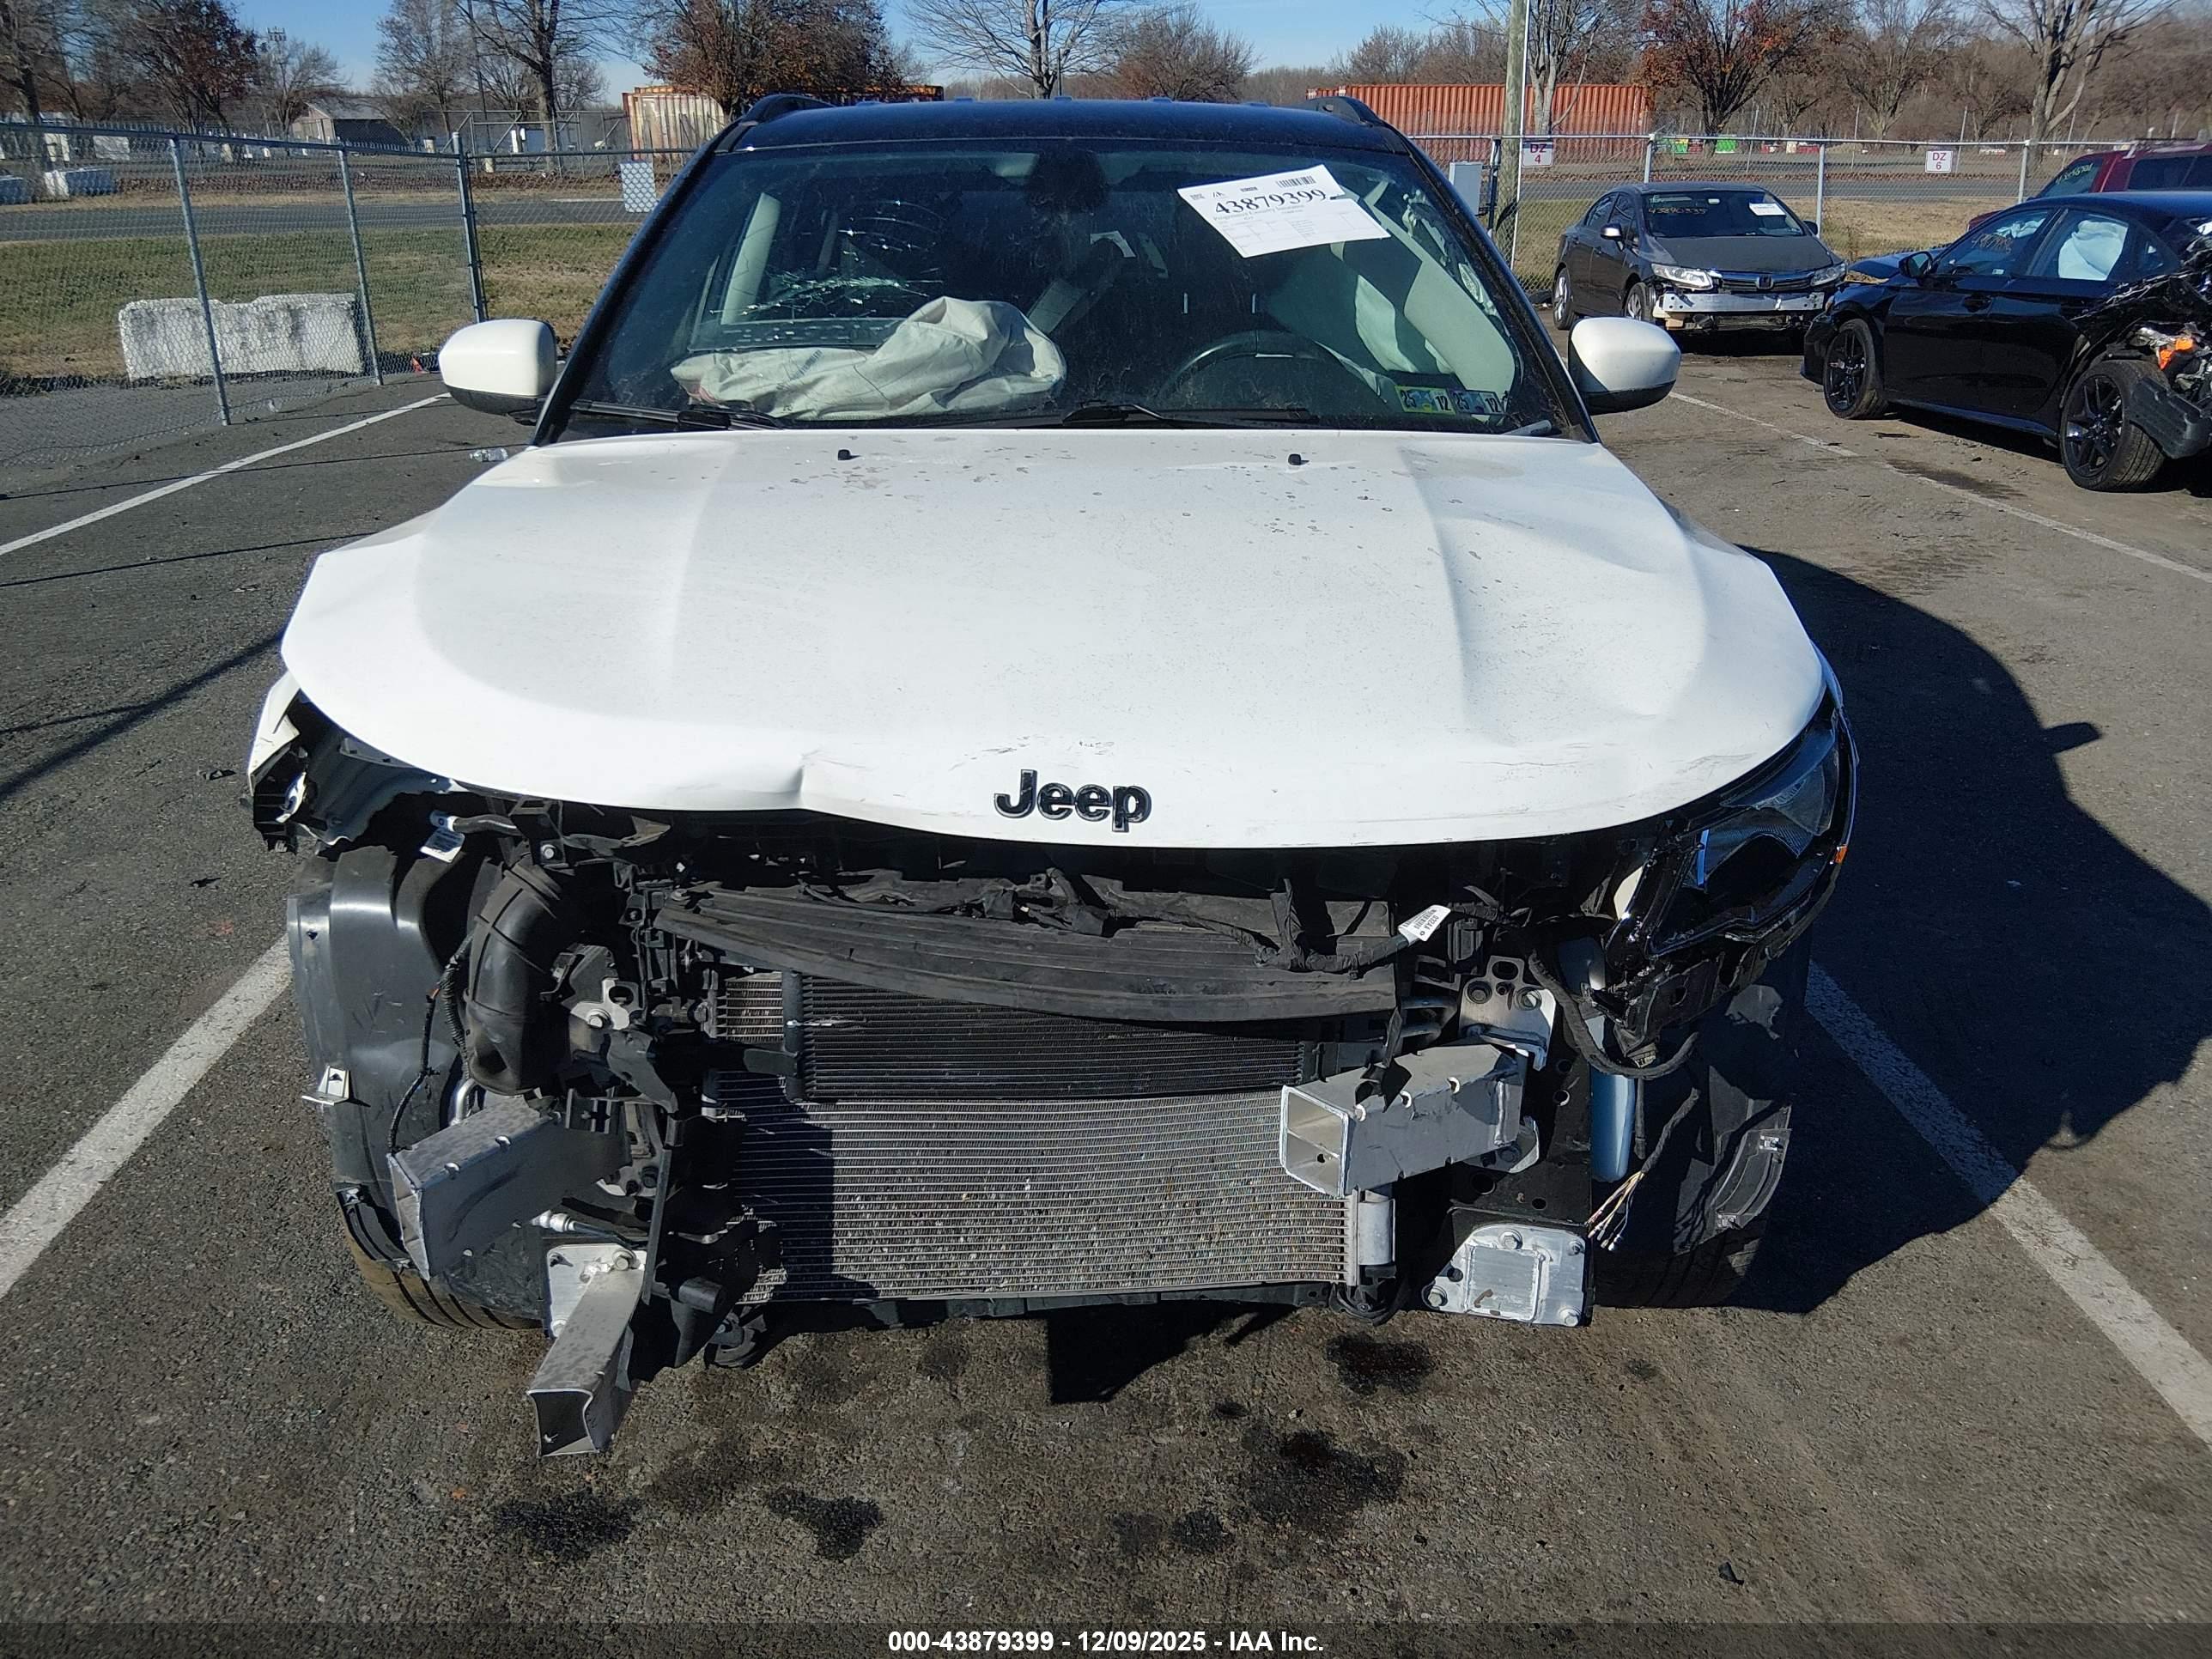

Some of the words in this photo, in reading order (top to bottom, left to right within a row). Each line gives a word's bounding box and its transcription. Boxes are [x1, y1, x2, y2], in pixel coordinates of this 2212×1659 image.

[1530, 143, 1547, 153] DZ
[1534, 155, 1541, 163] 4
[1932, 152, 1947, 161] DZ
[1936, 161, 1942, 170] 6
[1215, 188, 1327, 214] 43879399
[1435, 395, 1452, 411] 12
[1453, 392, 1470, 410] 25
[1485, 398, 1502, 413] 12
[994, 769, 1152, 833] Jeep
